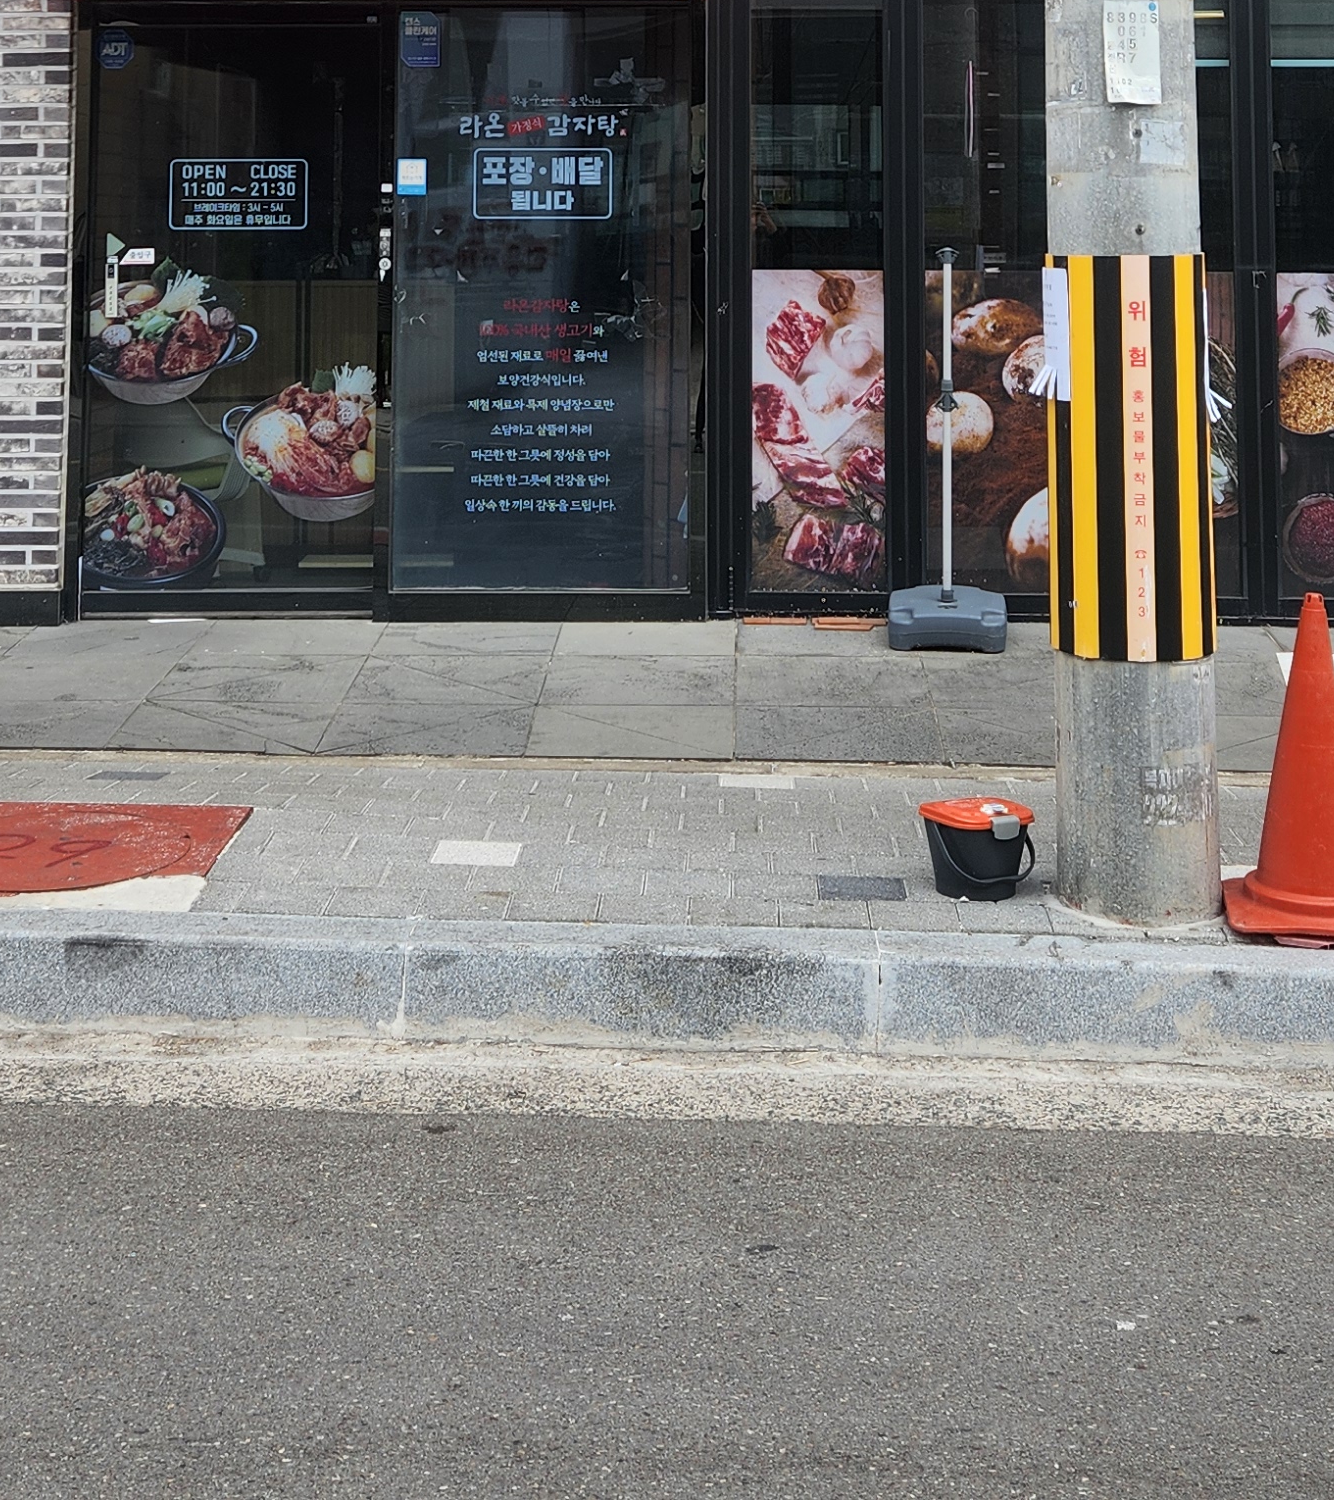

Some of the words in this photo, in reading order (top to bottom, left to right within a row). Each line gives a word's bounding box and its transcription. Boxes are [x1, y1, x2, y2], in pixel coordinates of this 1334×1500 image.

[101, 42, 128, 56] ADT
[459, 112, 505, 138] 라온
[547, 113, 619, 138] 감자탕
[182, 164, 227, 179] OPEN
[250, 164, 297, 179] CLOSE
[182, 181, 225, 197] 11:00
[250, 181, 296, 197] 21:30
[510, 190, 575, 211] 됩니다
[1127, 301, 1147, 368] 위험
